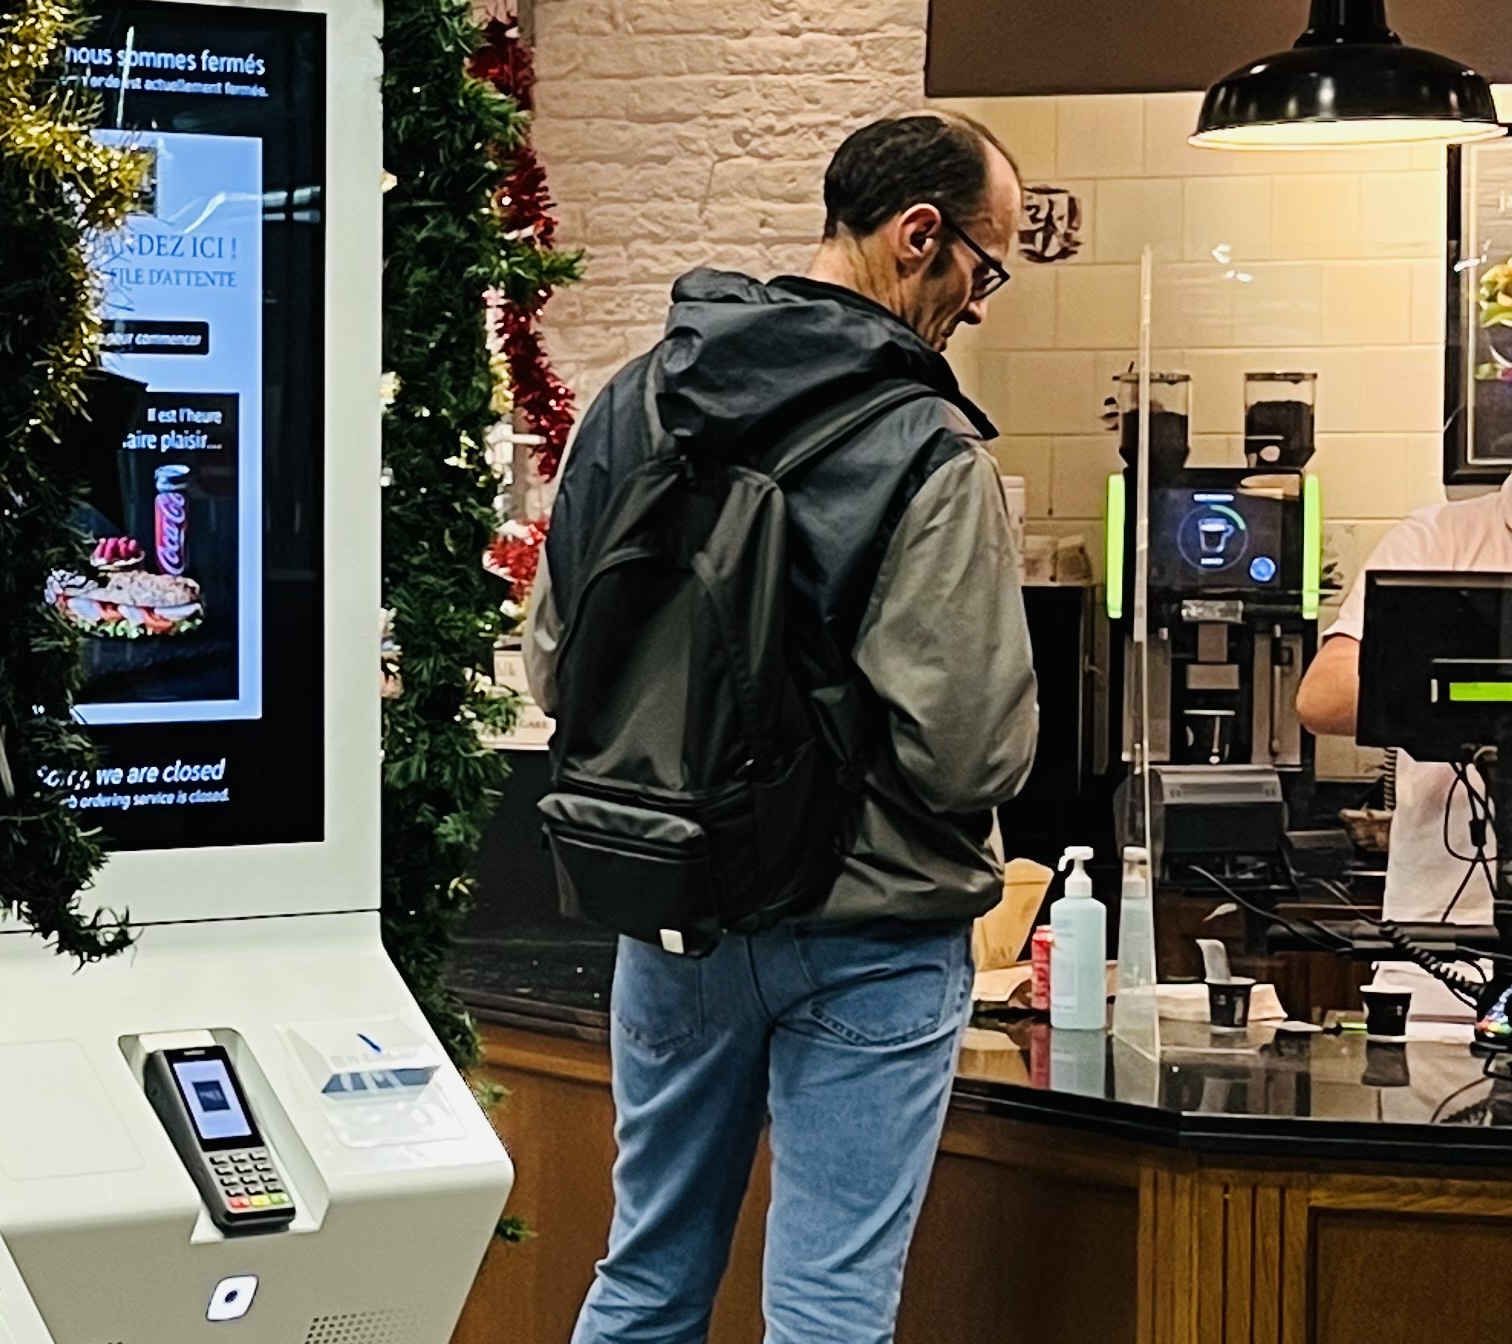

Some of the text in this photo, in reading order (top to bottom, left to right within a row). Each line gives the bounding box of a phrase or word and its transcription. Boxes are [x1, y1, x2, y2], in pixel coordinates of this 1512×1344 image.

[64, 46, 267, 76] nous sommes fermés
[191, 237, 224, 259] ICI
[96, 767, 124, 786] we
[126, 766, 160, 784] are
[162, 758, 227, 783] closed
